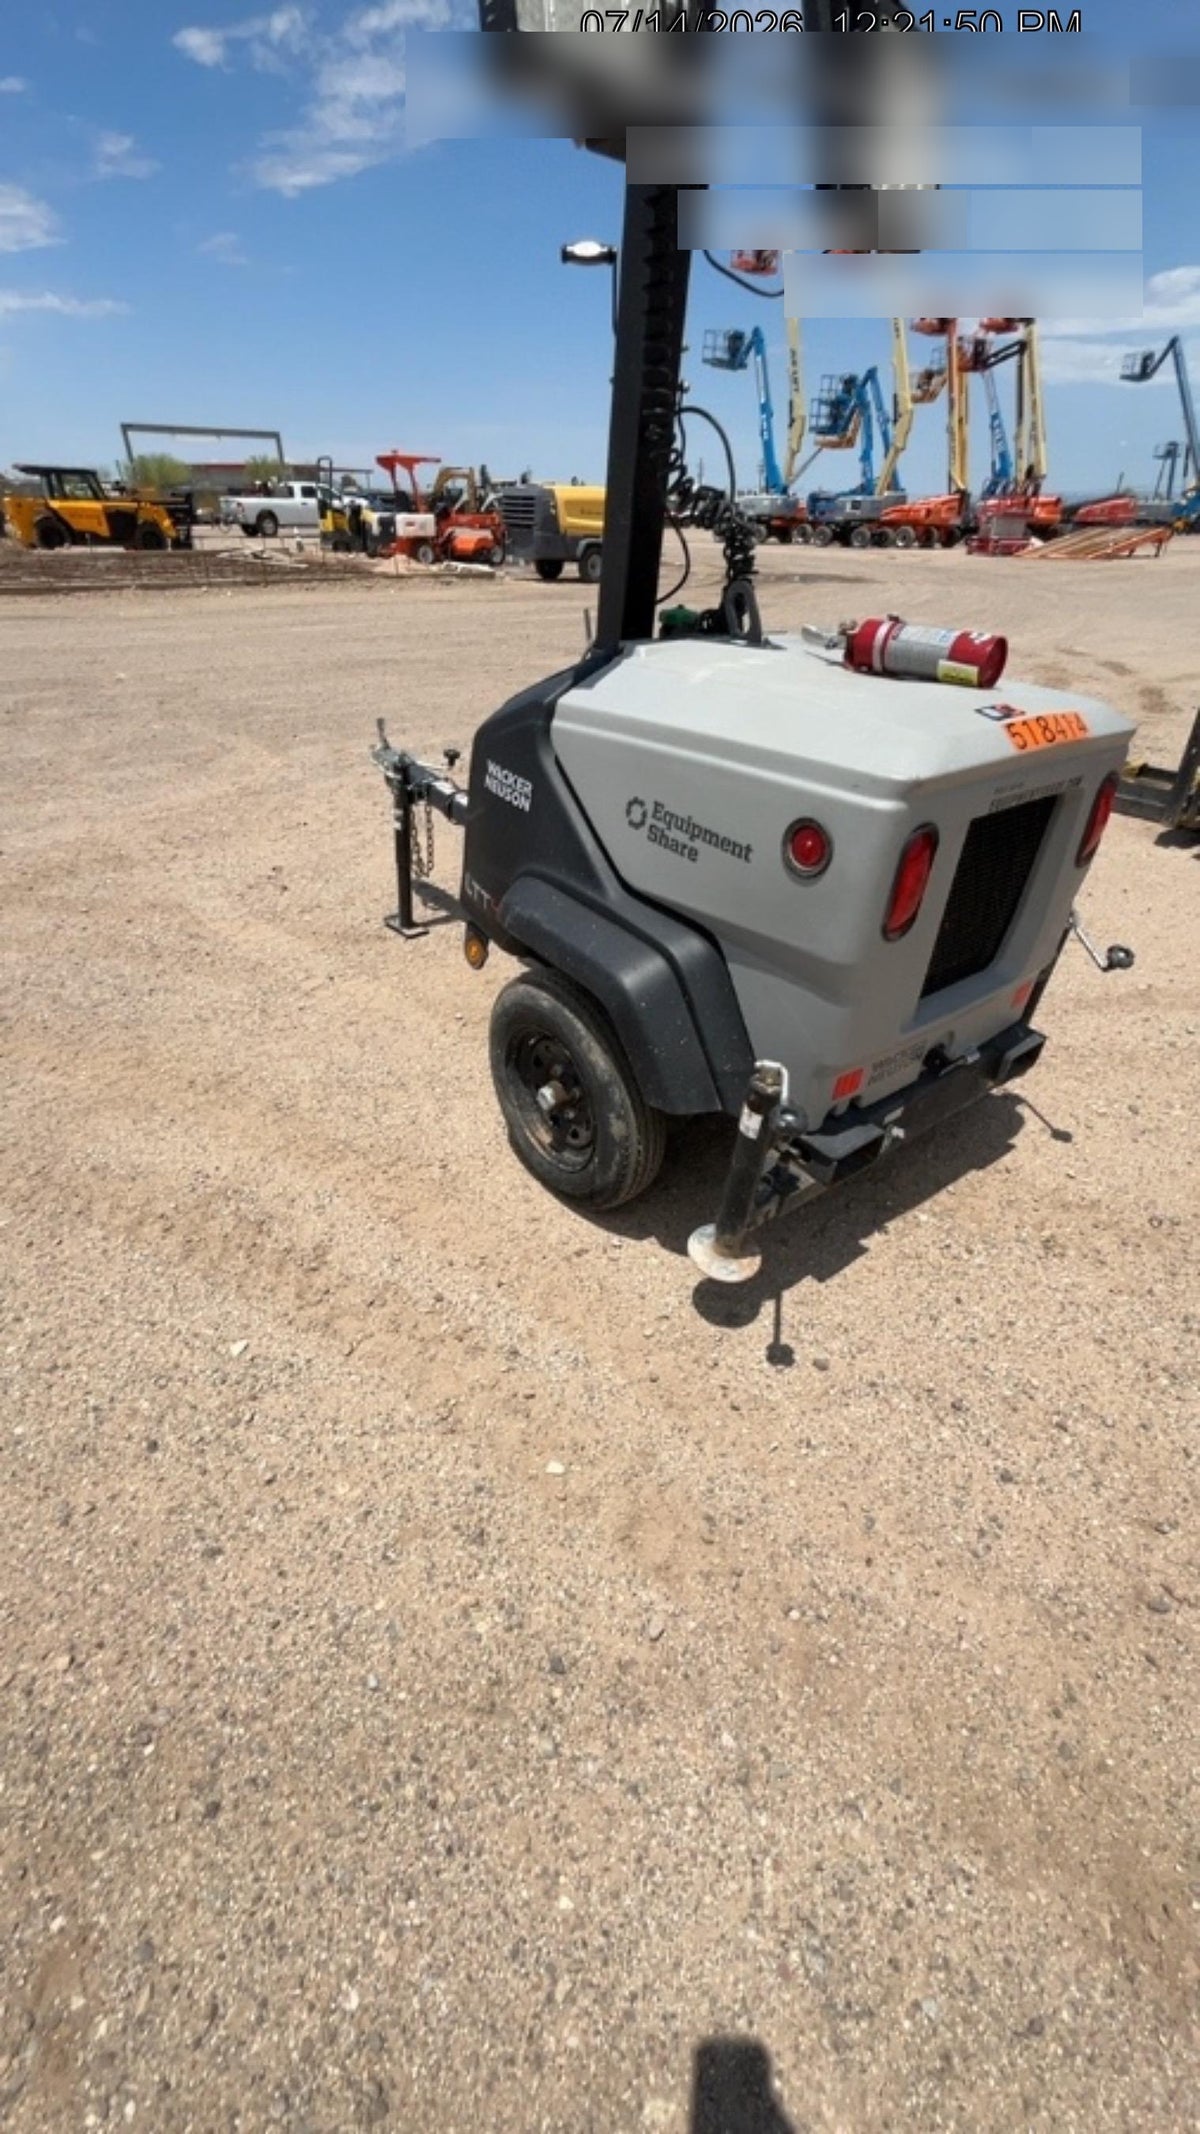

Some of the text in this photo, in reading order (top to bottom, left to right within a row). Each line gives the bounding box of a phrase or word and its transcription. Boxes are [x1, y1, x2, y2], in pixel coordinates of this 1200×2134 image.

[484, 774, 531, 812] NEUSON
[487, 758, 532, 791] WACKER
[647, 823, 699, 862] Share
[652, 800, 753, 863] Equipment
